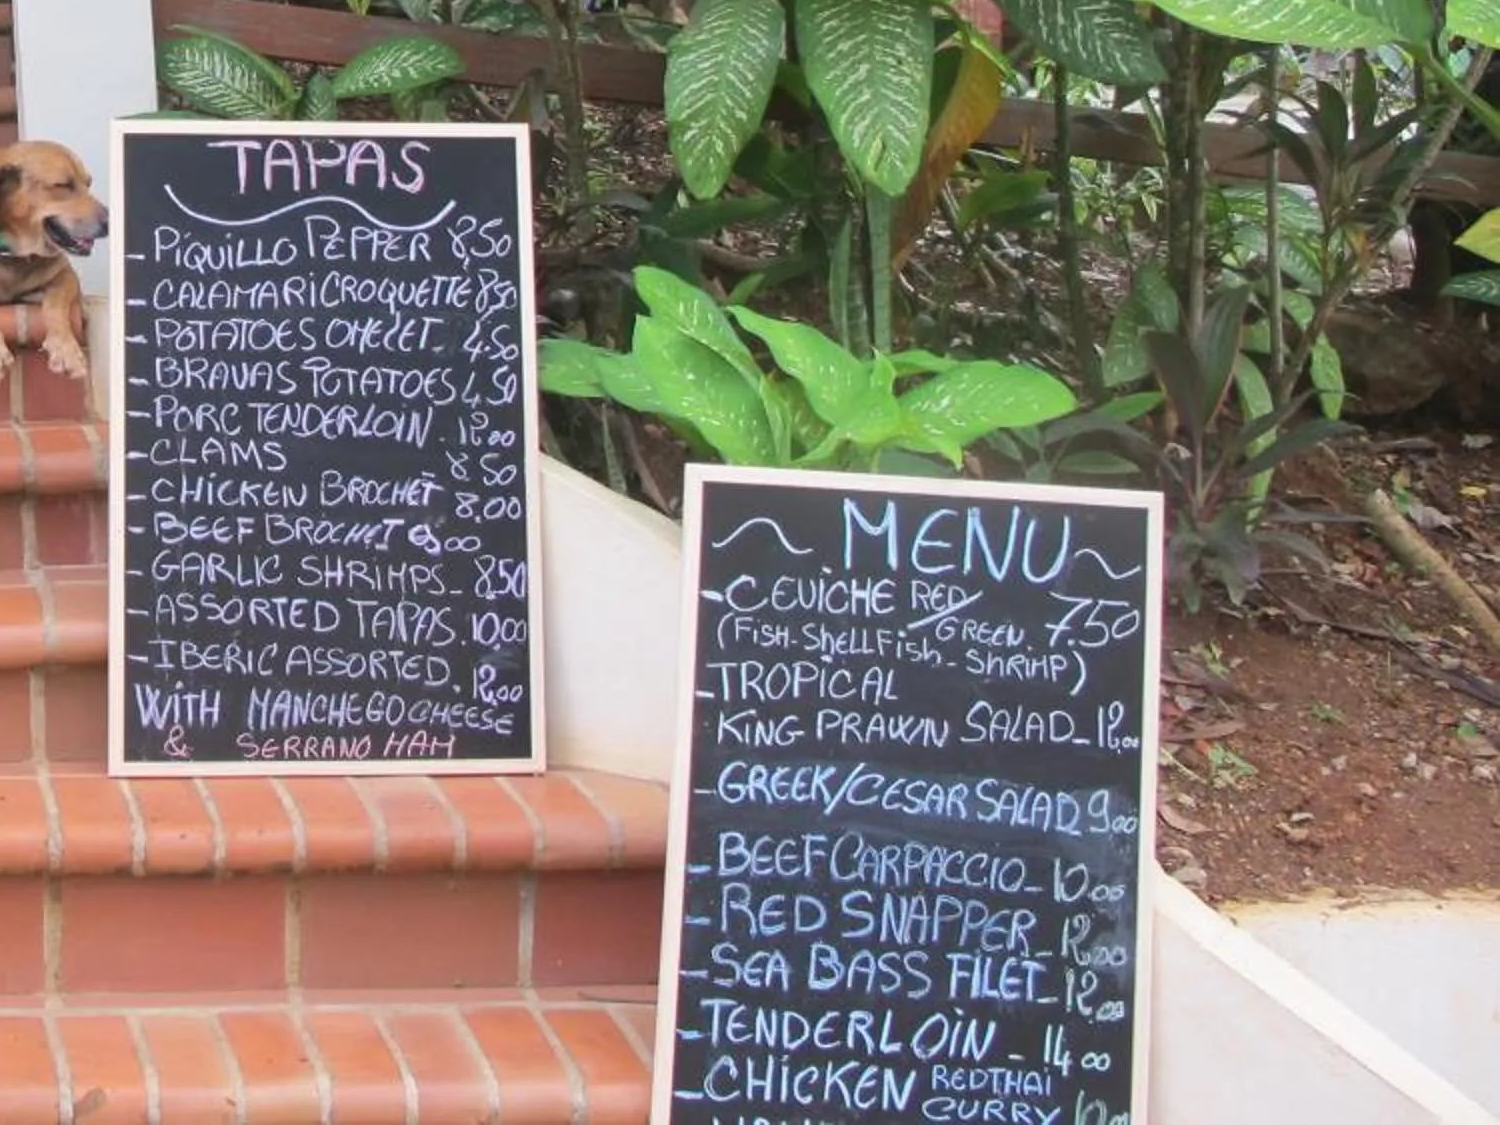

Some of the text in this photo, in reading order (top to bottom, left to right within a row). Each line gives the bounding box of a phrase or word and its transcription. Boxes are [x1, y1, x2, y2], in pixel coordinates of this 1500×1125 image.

[208, 138, 430, 194] TAPAS
[154, 225, 297, 274] PIQUILLO
[305, 216, 431, 264] PEPPER
[152, 277, 317, 313] CALAMARI
[319, 272, 473, 315] CROQUETTE
[155, 317, 317, 352] POTATOES
[301, 356, 457, 407] POTATOES
[153, 394, 242, 436] PORC
[247, 401, 433, 449] TENDERLOIN
[150, 437, 287, 471] CLAMS
[151, 472, 308, 508] CHICKEN
[320, 469, 444, 507] BROCHET
[153, 511, 255, 545] BEEF
[265, 512, 405, 551] BROCHET
[843, 495, 1071, 585] MENU
[151, 550, 283, 586] GARLIC
[154, 593, 341, 633] ASSORTED
[148, 639, 451, 687] IBERIC ASSORTED
[706, 654, 899, 704] TROPICAL
[134, 680, 515, 735] WITH MANCHEGO CHEESE
[717, 709, 802, 747] KING
[816, 709, 949, 749] PRAWN
[960, 700, 1076, 743] SALAD
[163, 725, 193, 757] &
[237, 732, 371, 760] SERRANO
[976, 786, 1082, 836] SALAD
[719, 831, 827, 877] BEEF
[831, 832, 1026, 892] CARPACCIO
[721, 881, 828, 941] RED
[841, 890, 1038, 954] SNAPPER
[711, 941, 790, 992] SEA
[809, 940, 933, 1001] BASS
[946, 951, 1047, 1004] FILET
[700, 997, 998, 1062] TENDERLOIN
[702, 1052, 918, 1112] CHICKEN
[921, 1095, 1062, 1125] CURRY
